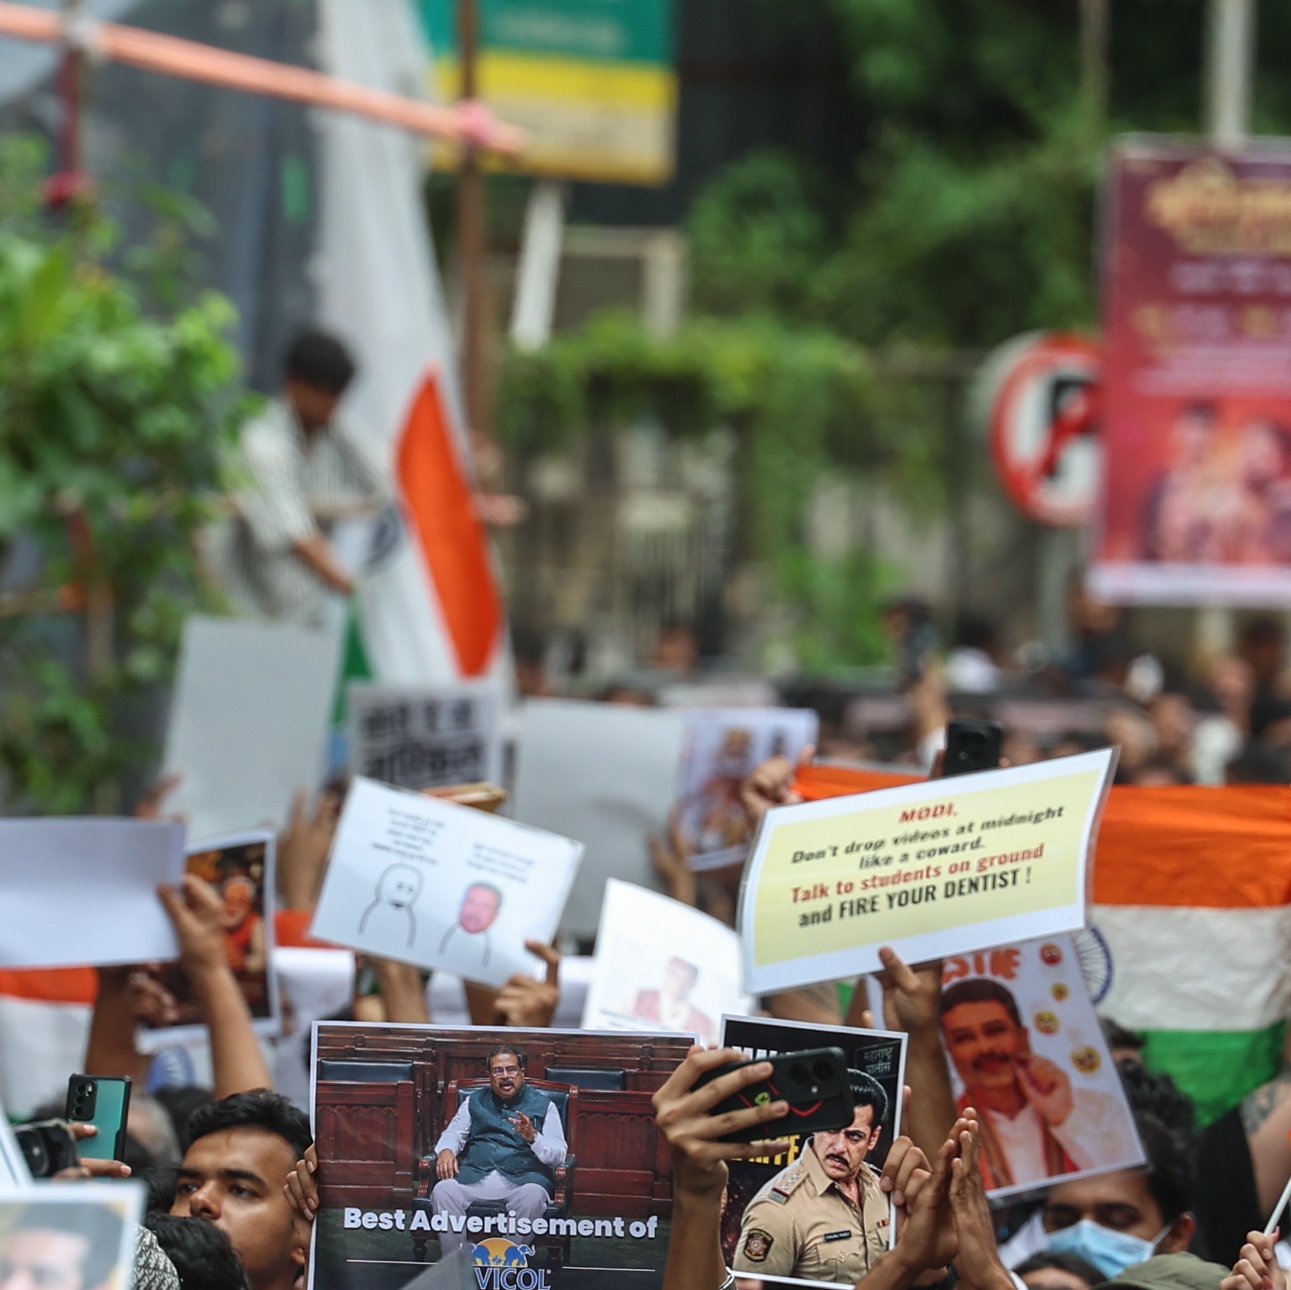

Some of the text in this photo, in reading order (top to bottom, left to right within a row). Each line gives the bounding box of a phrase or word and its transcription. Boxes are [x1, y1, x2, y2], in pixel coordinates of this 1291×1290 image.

[791, 806, 1064, 864] Don't drop videos at midnight
[898, 802, 959, 824] MODI,
[790, 843, 1045, 904] Talk to students on ground
[858, 837, 985, 870] like a coward.
[798, 903, 833, 928] and
[838, 894, 880, 919] FIRE
[887, 885, 937, 911] YOUR
[943, 868, 1021, 898] DENTIST
[343, 1207, 658, 1238] Best Advertisement of
